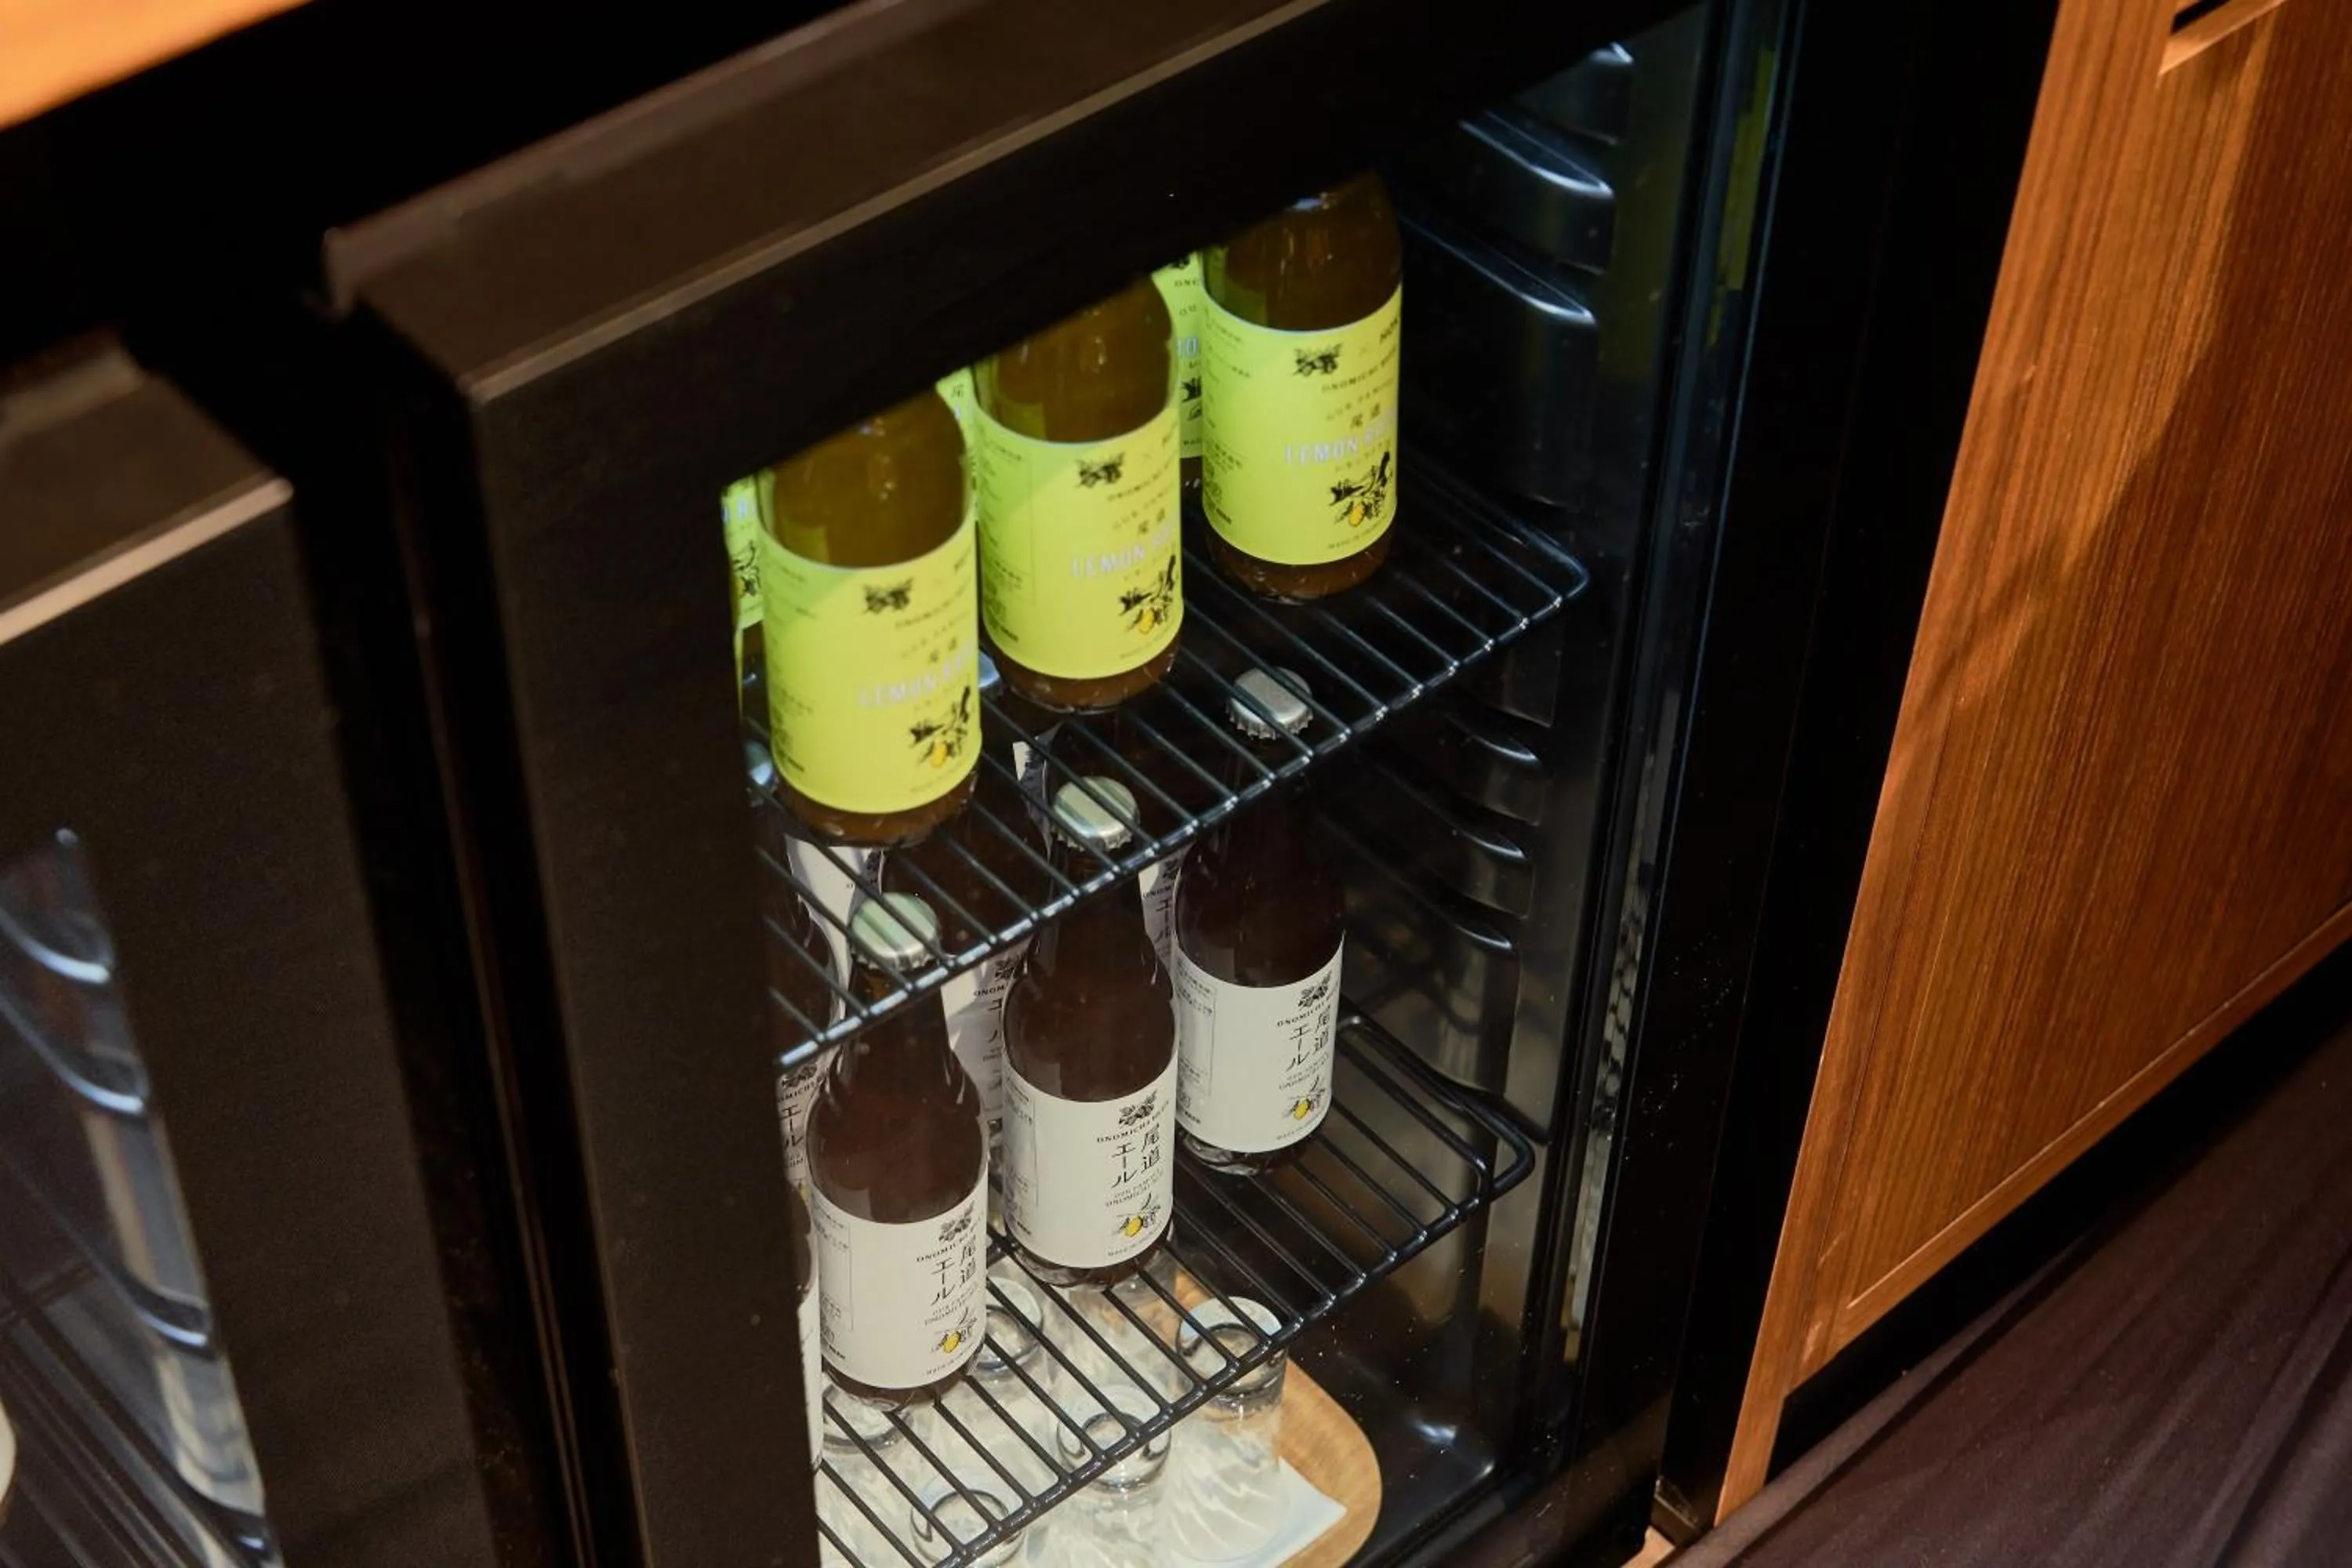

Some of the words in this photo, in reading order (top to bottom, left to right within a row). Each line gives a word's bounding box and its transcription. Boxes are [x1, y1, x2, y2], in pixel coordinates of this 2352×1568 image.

[1284, 434, 1359, 465] LEMON
[1071, 544, 1147, 579] LEMON
[858, 676, 938, 708] LEMON
[1289, 1023, 1311, 1072] エール
[1097, 1120, 1150, 1143] ONOMICHI
[1141, 1123, 1160, 1174] 尾道
[1111, 1143, 1137, 1189] エール
[931, 1257, 956, 1306] エール
